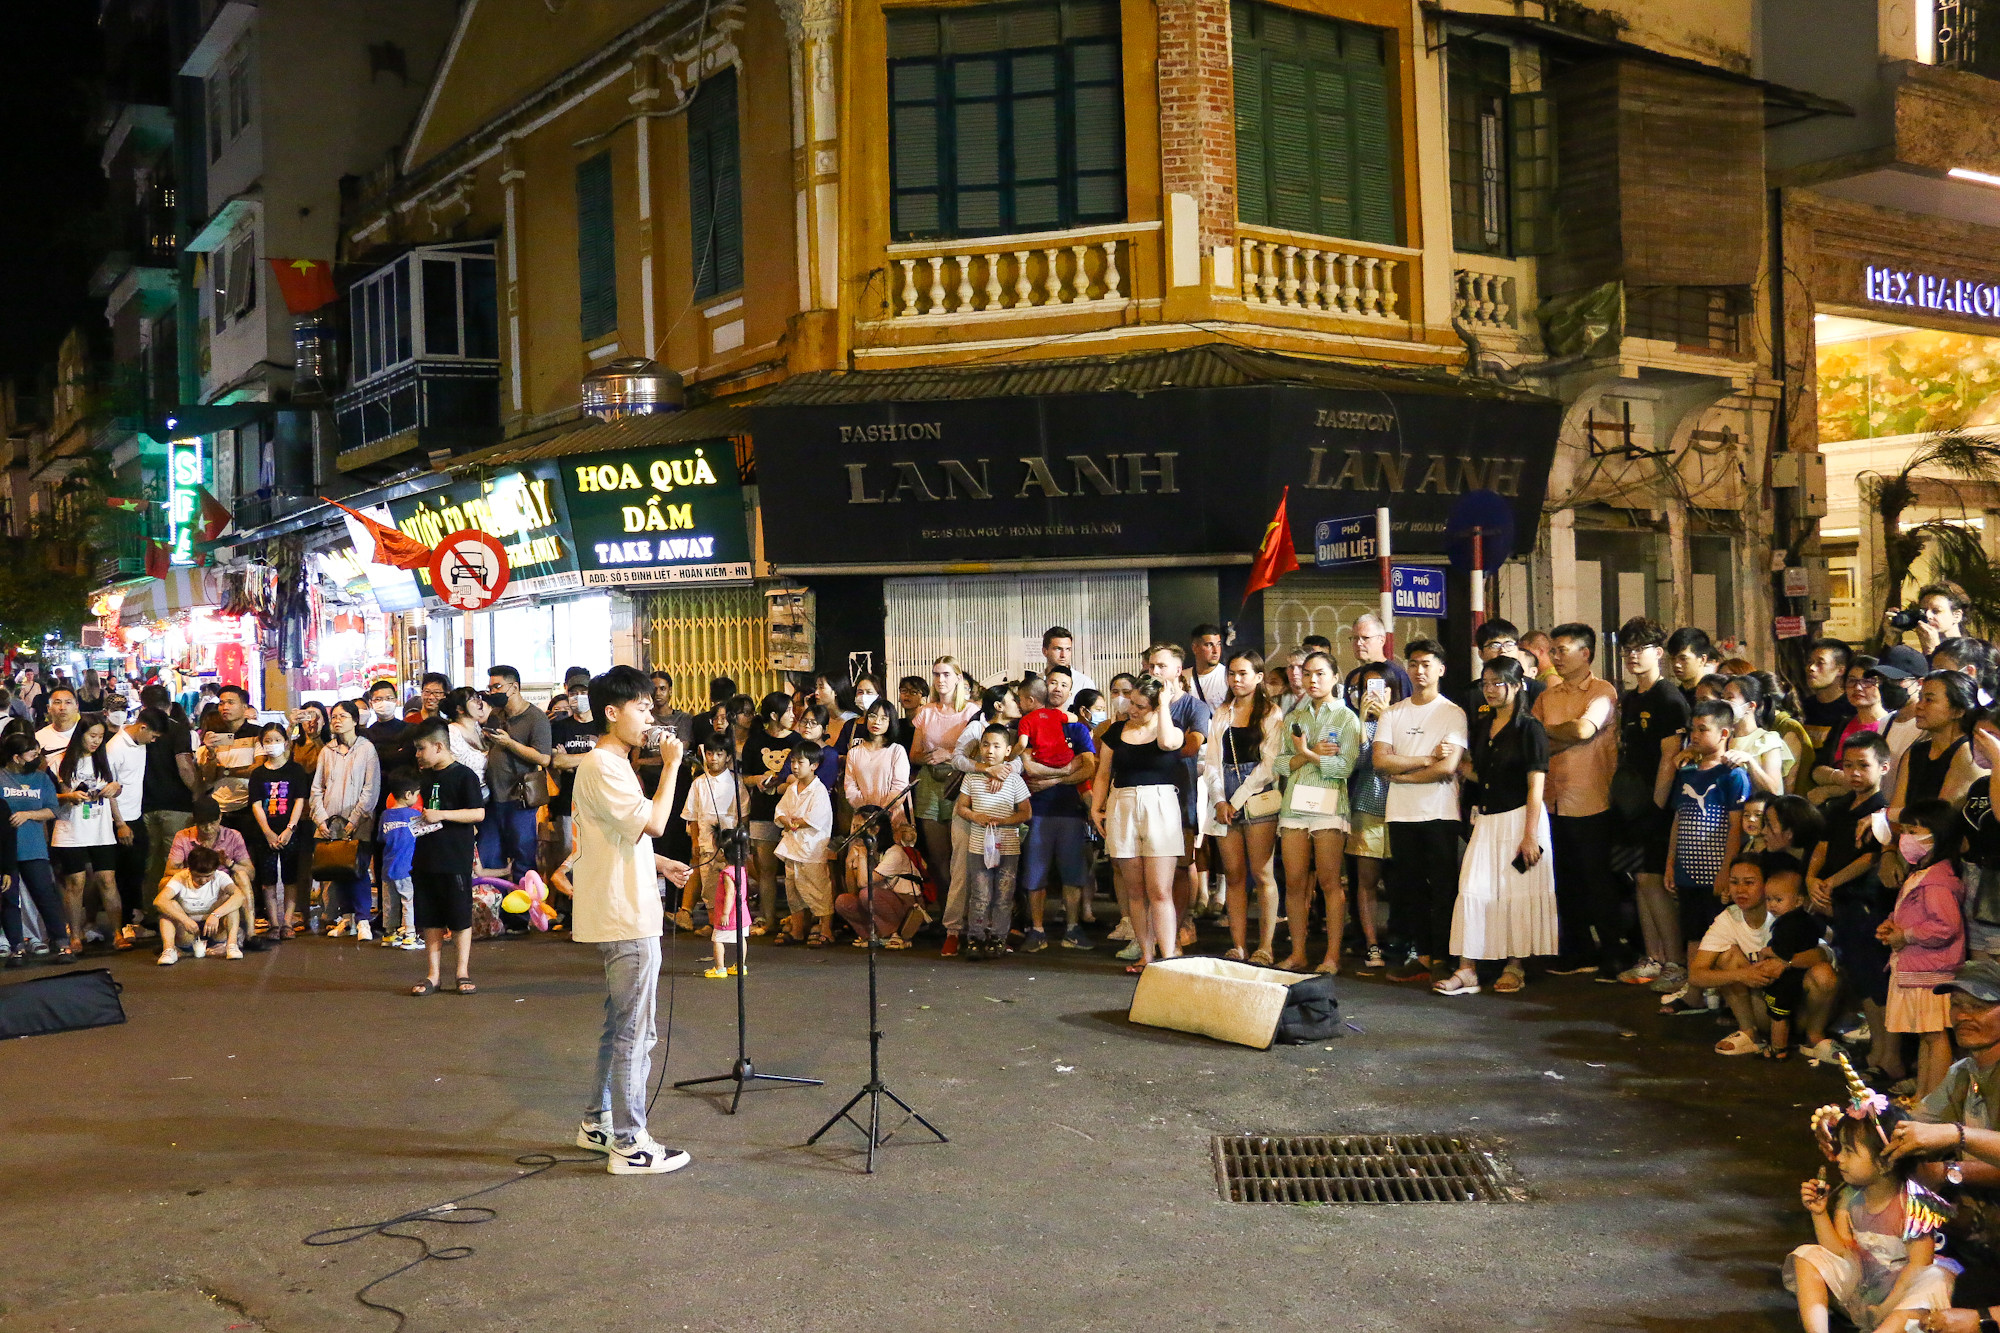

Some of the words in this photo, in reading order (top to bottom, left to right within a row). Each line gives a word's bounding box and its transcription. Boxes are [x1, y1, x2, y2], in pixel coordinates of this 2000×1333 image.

[1866, 265, 1914, 305] REX
[1315, 409, 1393, 432] FASHION
[839, 422, 942, 443] FASHION
[576, 463, 643, 492] HOA
[650, 448, 717, 492] QUẢ
[844, 459, 994, 504] LAN
[1014, 452, 1179, 498] ANH
[1302, 447, 1411, 493] LAN
[1416, 454, 1525, 497] ANH
[1342, 521, 1360, 535] PHỐ
[595, 541, 653, 564] TAKE
[658, 537, 714, 560] AWAY
[1350, 536, 1375, 559] LIỆT
[589, 573, 609, 583] ADD:
[624, 573, 630, 581] 5
[735, 566, 748, 576] HN
[1413, 574, 1429, 586] PHỐ
[1396, 589, 1415, 608] GIA
[1417, 591, 1441, 609] NGƯ
